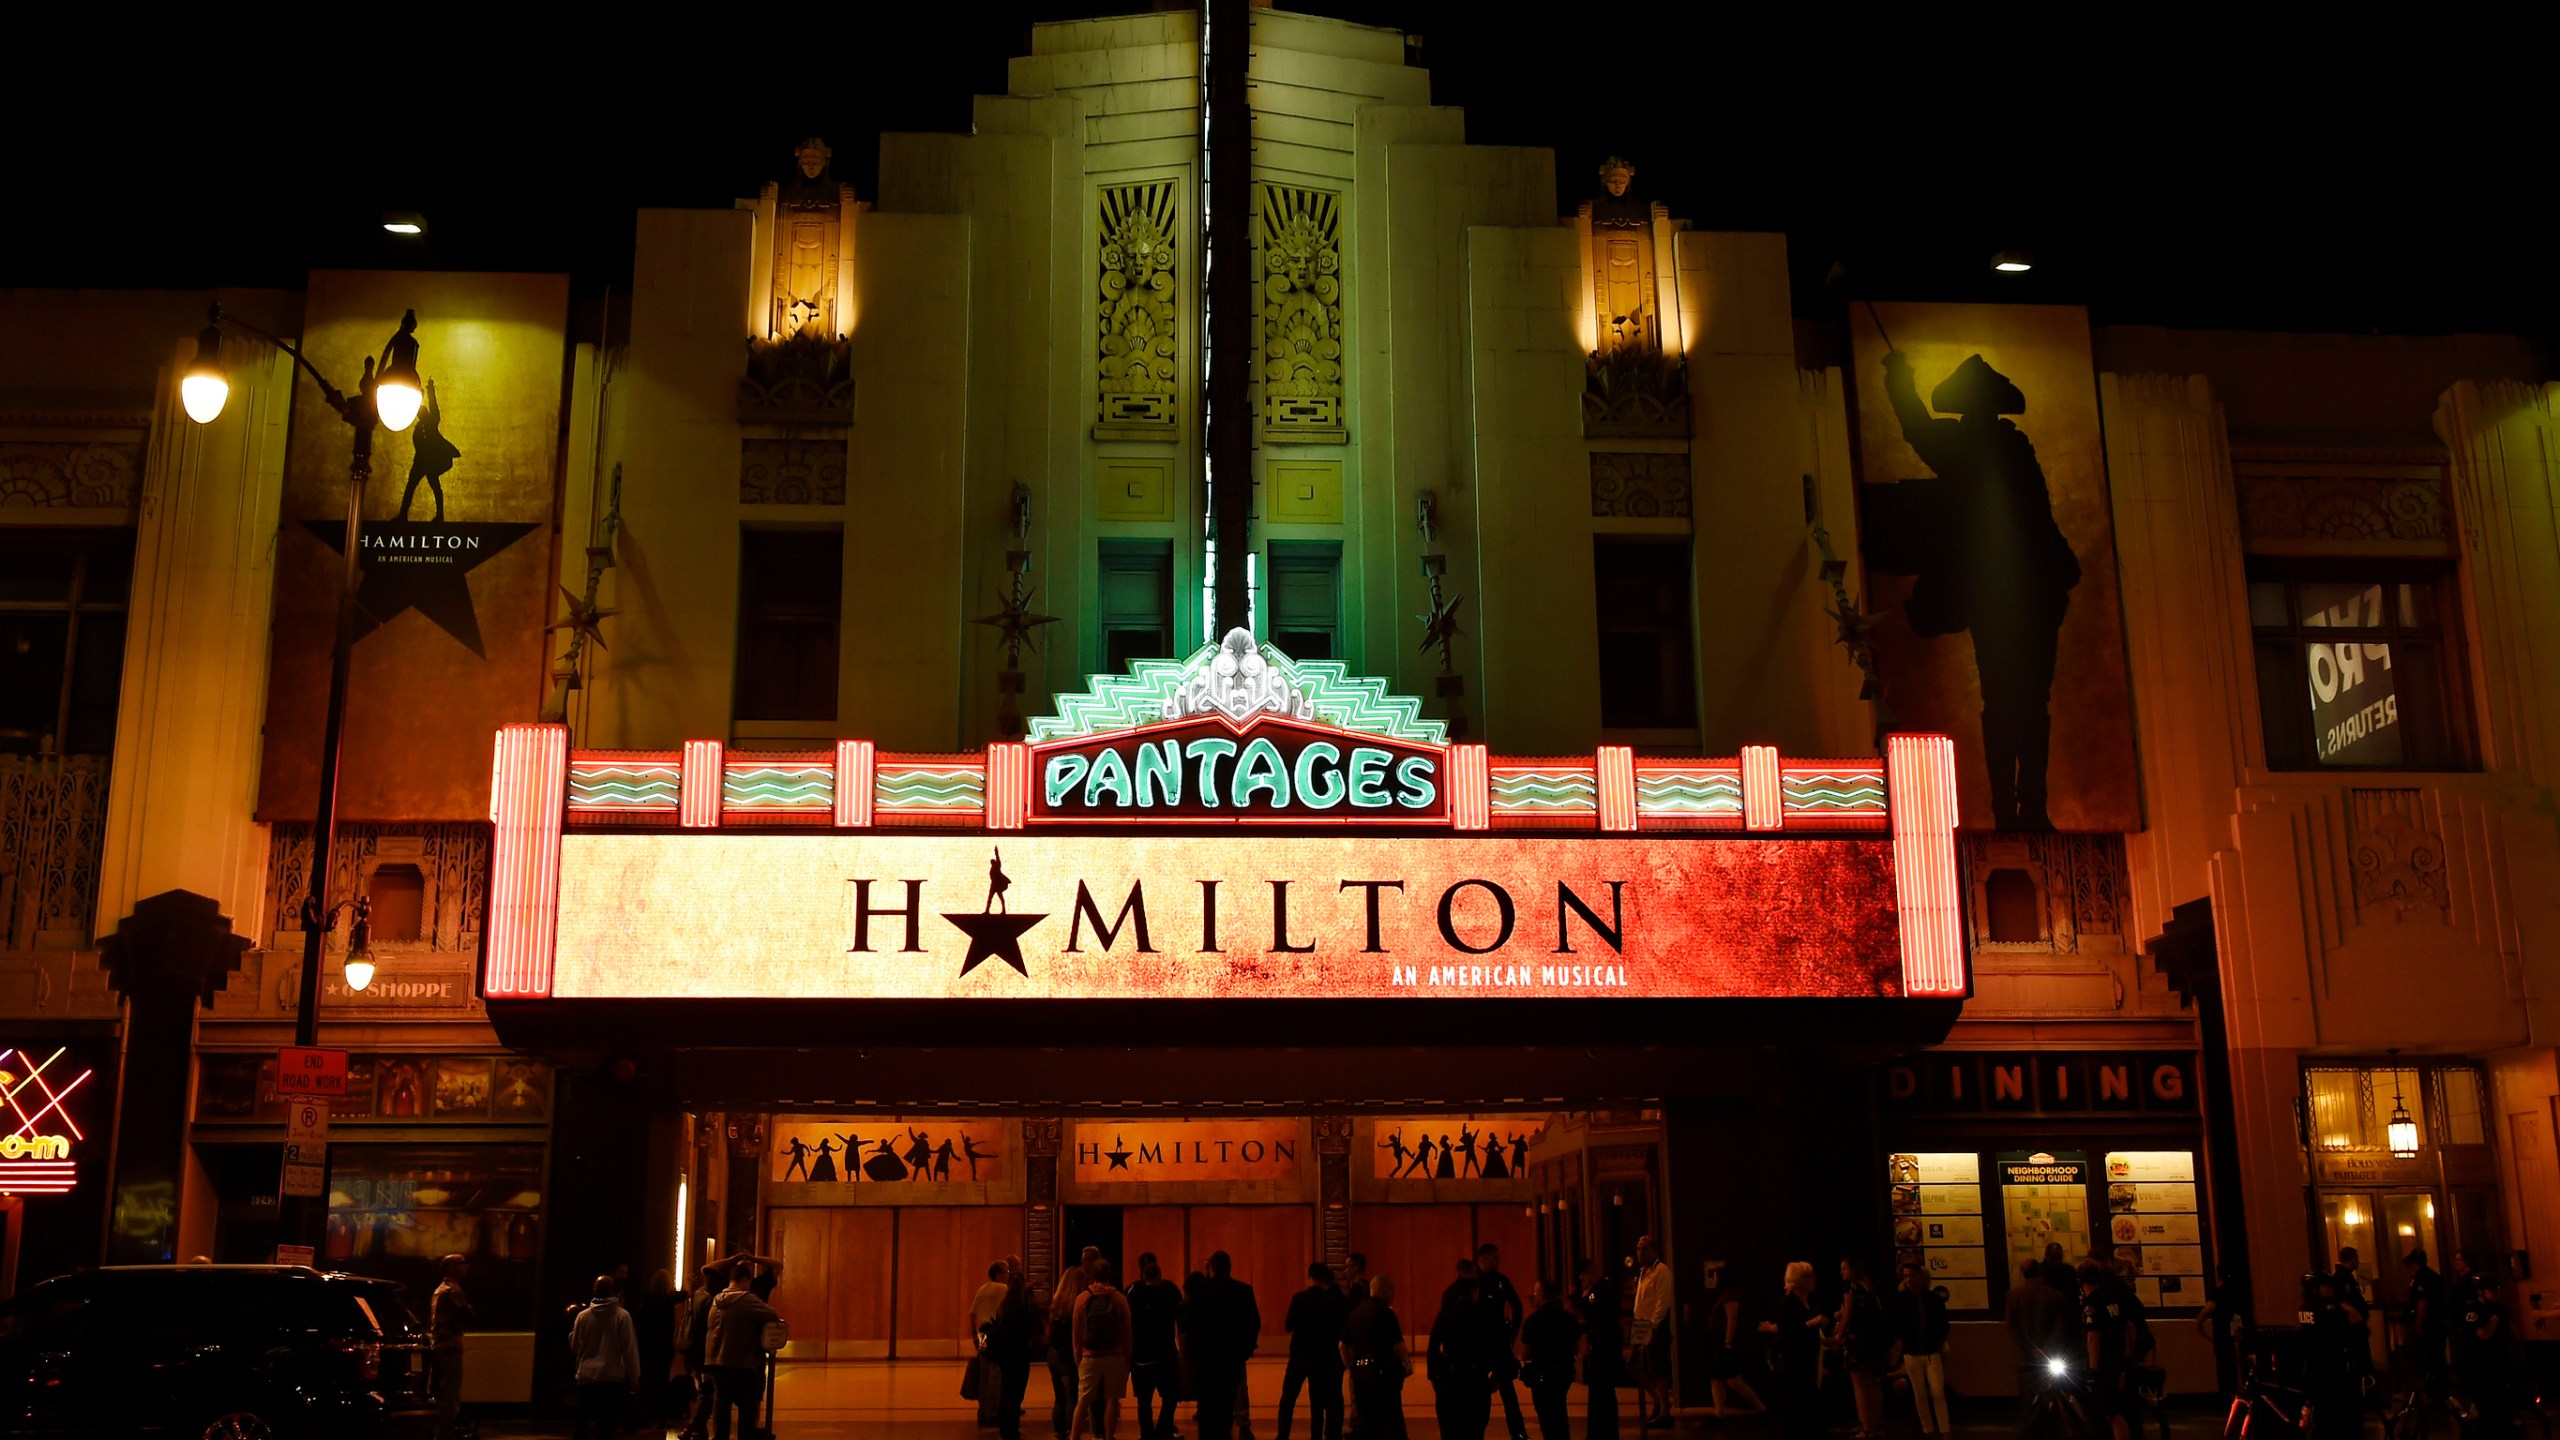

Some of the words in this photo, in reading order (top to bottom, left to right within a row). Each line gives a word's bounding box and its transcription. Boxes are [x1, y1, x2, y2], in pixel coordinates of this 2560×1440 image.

[377, 555, 387, 563] AN
[388, 555, 423, 563] AMERICAN
[425, 556, 454, 564] MUSICAL
[1043, 737, 1437, 811] PANTAGES
[1391, 965, 1418, 986] AN
[1428, 965, 1532, 987] AMERICAN
[1542, 965, 1628, 987] MUSICAL
[366, 982, 453, 998] SHOPPE
[304, 1054, 323, 1069] END
[282, 1073, 310, 1088] ROAD
[315, 1074, 342, 1090] WORK
[1888, 1064, 2183, 1101] DINING
[2007, 1166, 2079, 1175] NEIGHBORHOOD
[2013, 1174, 2045, 1183] DINING
[2047, 1174, 2074, 1183] GUIDE
